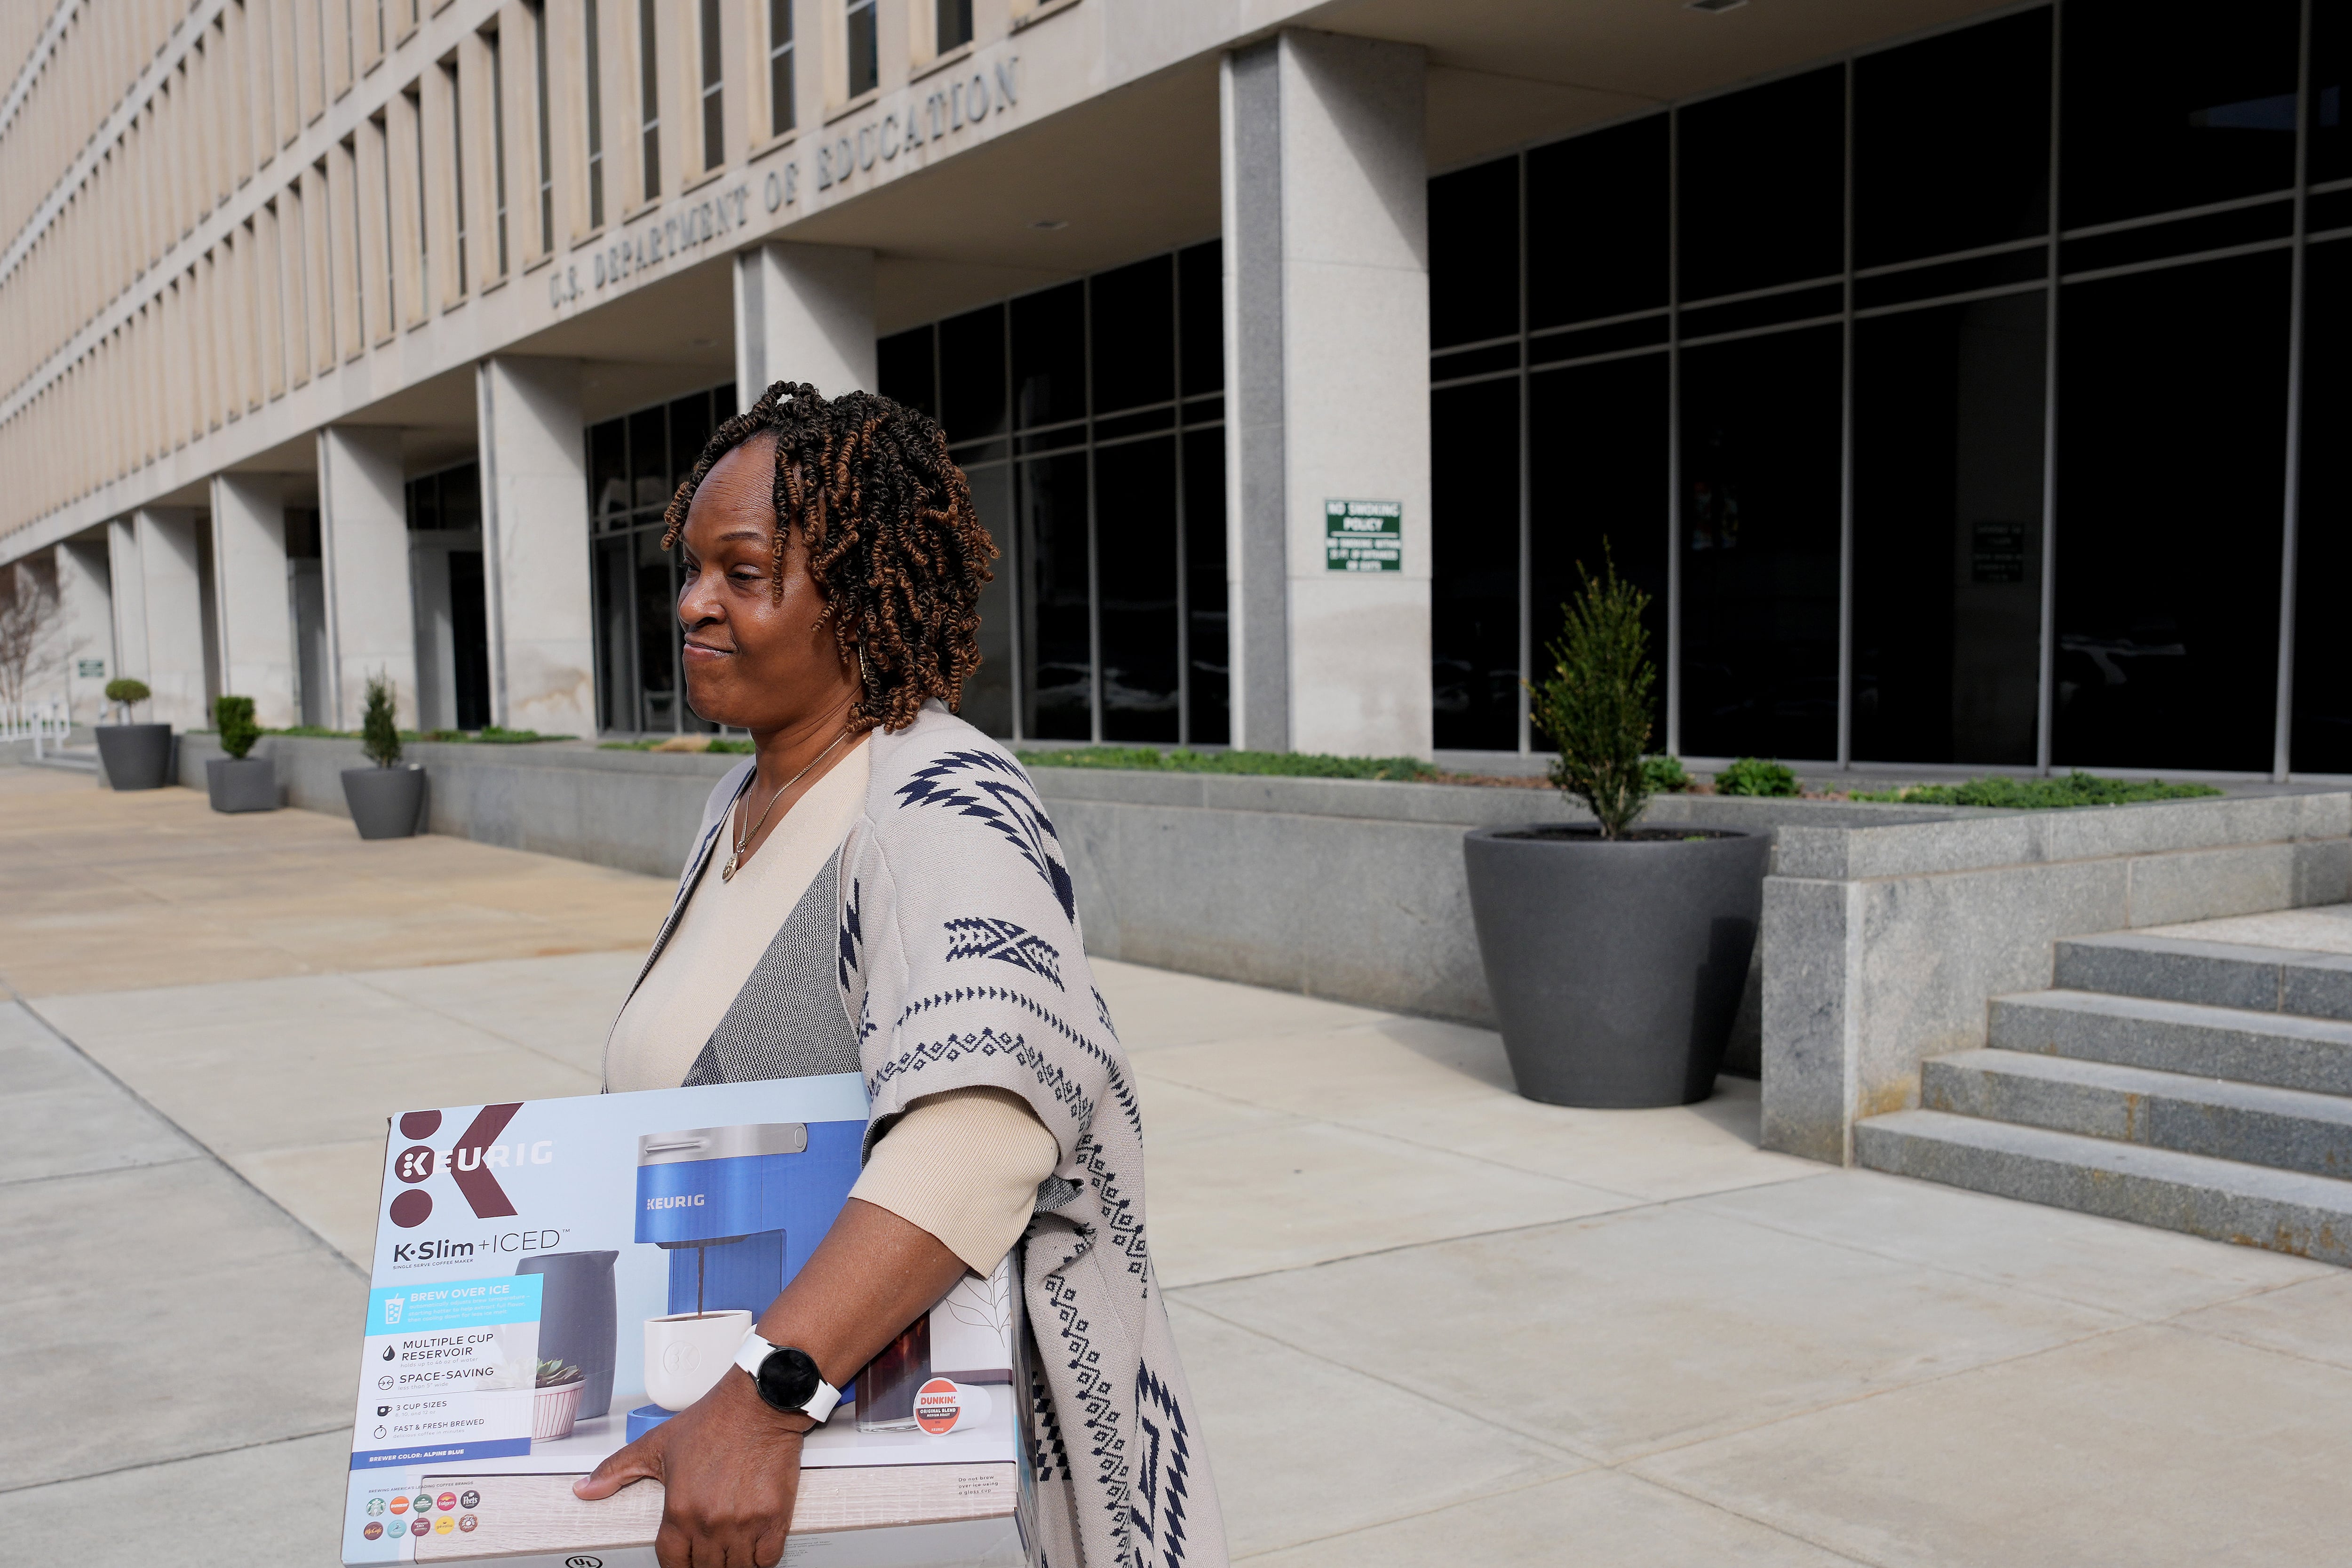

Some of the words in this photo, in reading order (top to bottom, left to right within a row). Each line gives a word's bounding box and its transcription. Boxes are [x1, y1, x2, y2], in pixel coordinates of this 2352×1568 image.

[549, 271, 584, 310] U.S.
[594, 185, 750, 289] DEPARTMENT
[763, 162, 799, 214] OF
[817, 56, 1020, 191] EDUCATION
[403, 1140, 553, 1178] KEURIG
[647, 1194, 705, 1210] KEURIG
[411, 1290, 449, 1302] BREW
[451, 1286, 486, 1298] OVER
[489, 1284, 510, 1295] ICE
[403, 1336, 464, 1349] MULTIPLE
[468, 1333, 494, 1344] CUP
[402, 1346, 473, 1361] RESERVOIR
[399, 1367, 494, 1384] SPACE-SAVING
[422, 1400, 447, 1409] SIZES
[921, 1396, 956, 1405] DUNKIN'
[394, 1424, 414, 1433] FAST
[423, 1421, 448, 1430] FRESH
[450, 1418, 485, 1428] BREWED
[369, 1454, 397, 1463] BREWER
[423, 1449, 447, 1458] ALPINE
[573, 1558, 597, 1567] UL
